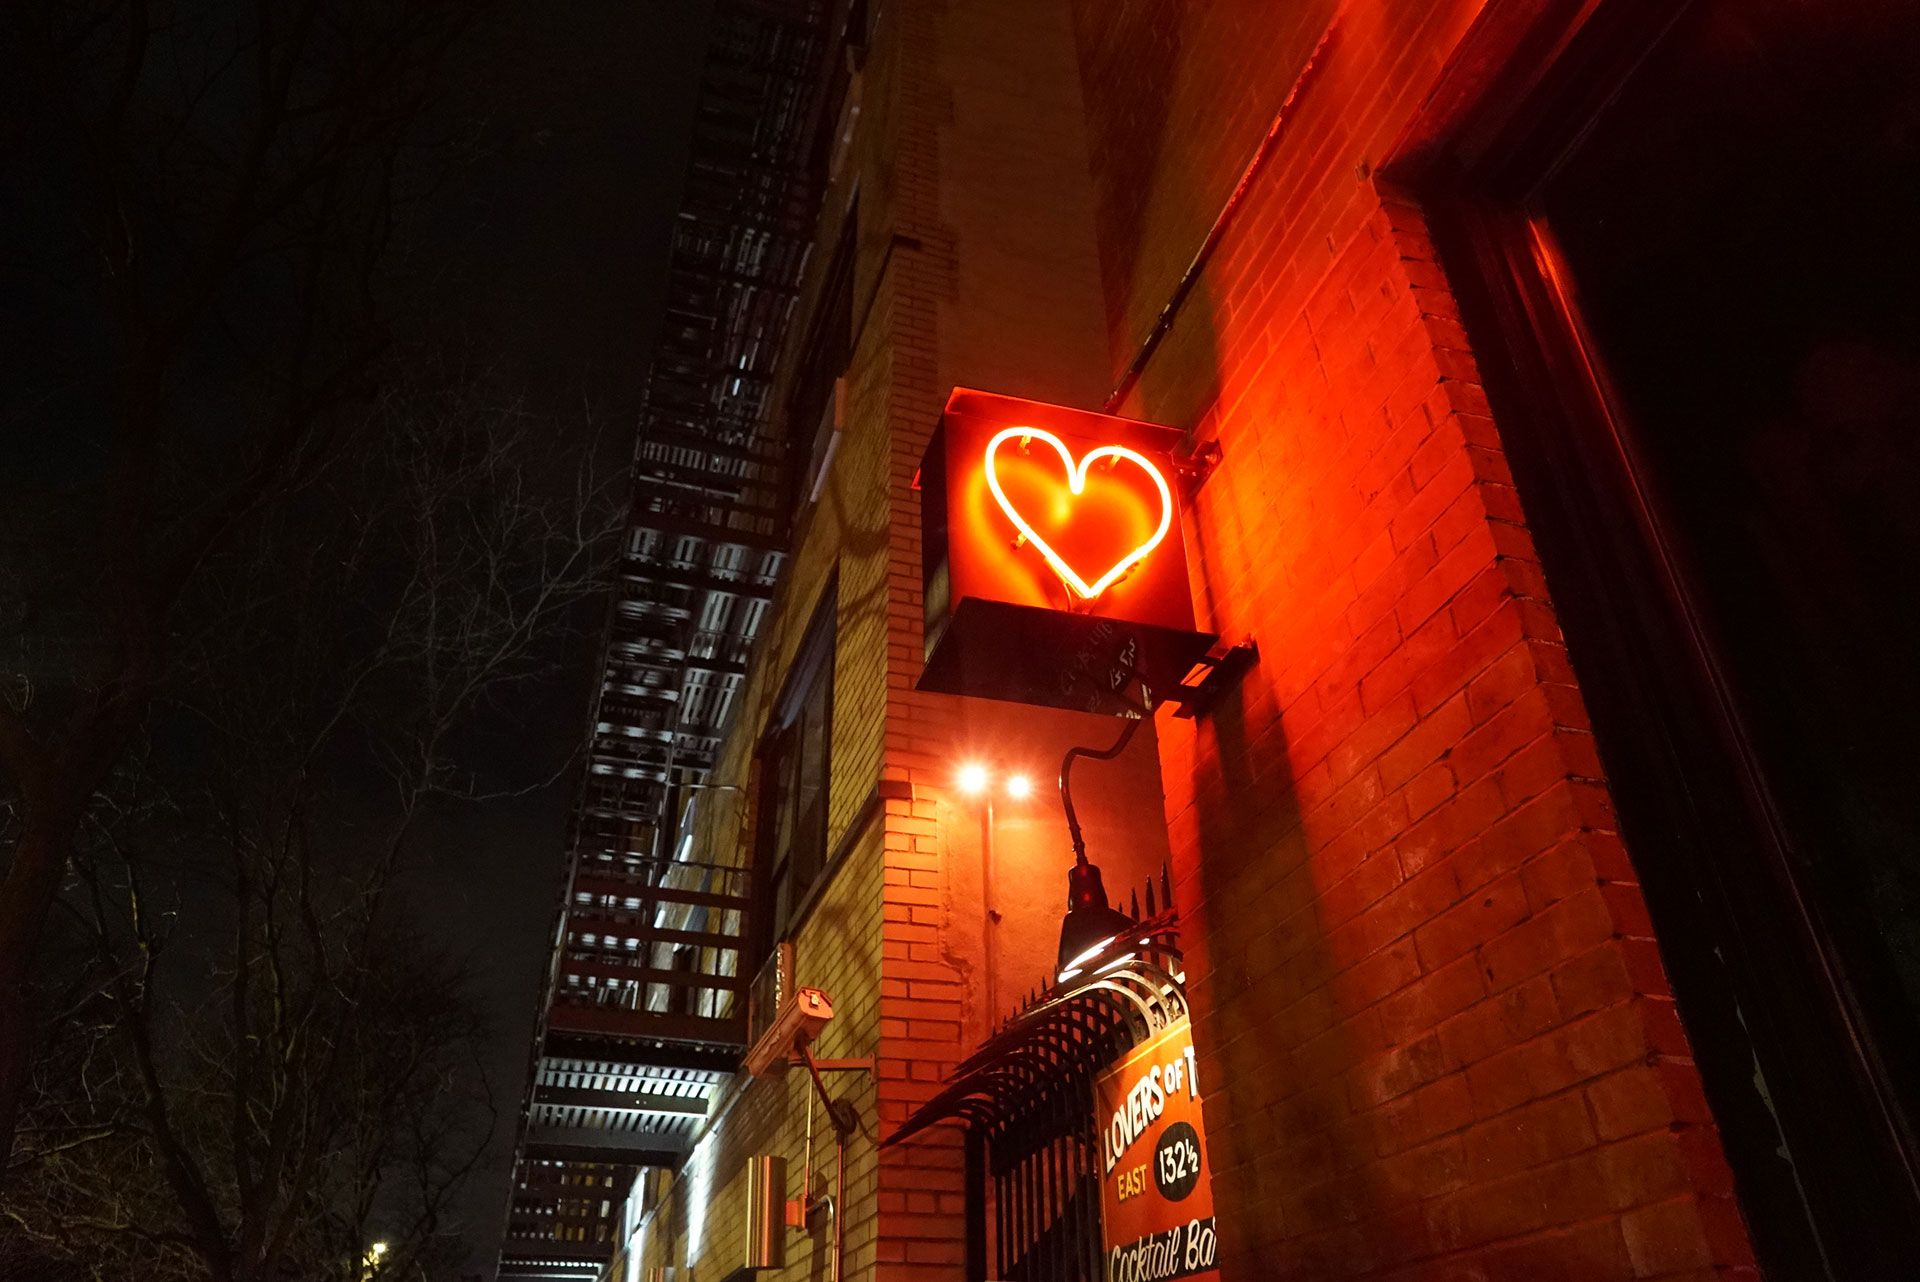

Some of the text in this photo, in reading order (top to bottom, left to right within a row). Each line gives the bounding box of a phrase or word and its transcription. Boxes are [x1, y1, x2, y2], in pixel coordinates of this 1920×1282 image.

[1104, 1064, 1165, 1173] LOVERS
[1164, 1058, 1183, 1094] OF
[1118, 1164, 1147, 1201] EAST
[1110, 1226, 1181, 1282] Cocktail
